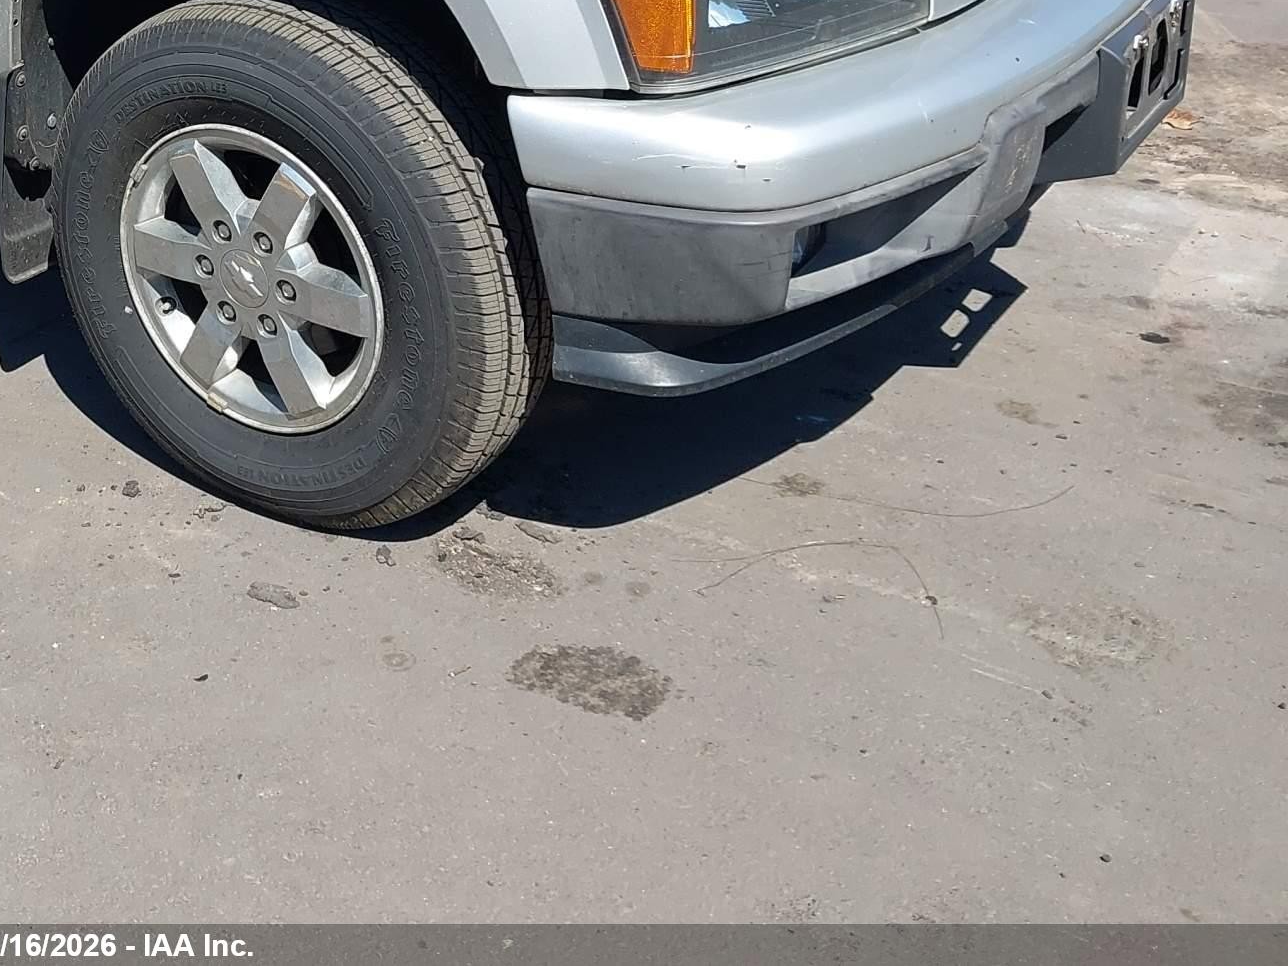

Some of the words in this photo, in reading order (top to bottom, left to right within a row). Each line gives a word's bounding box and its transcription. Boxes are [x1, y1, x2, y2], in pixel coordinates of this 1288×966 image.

[113, 80, 207, 123] DESTINATION
[73, 170, 117, 339] Firestone
[376, 218, 424, 410] Firestone
